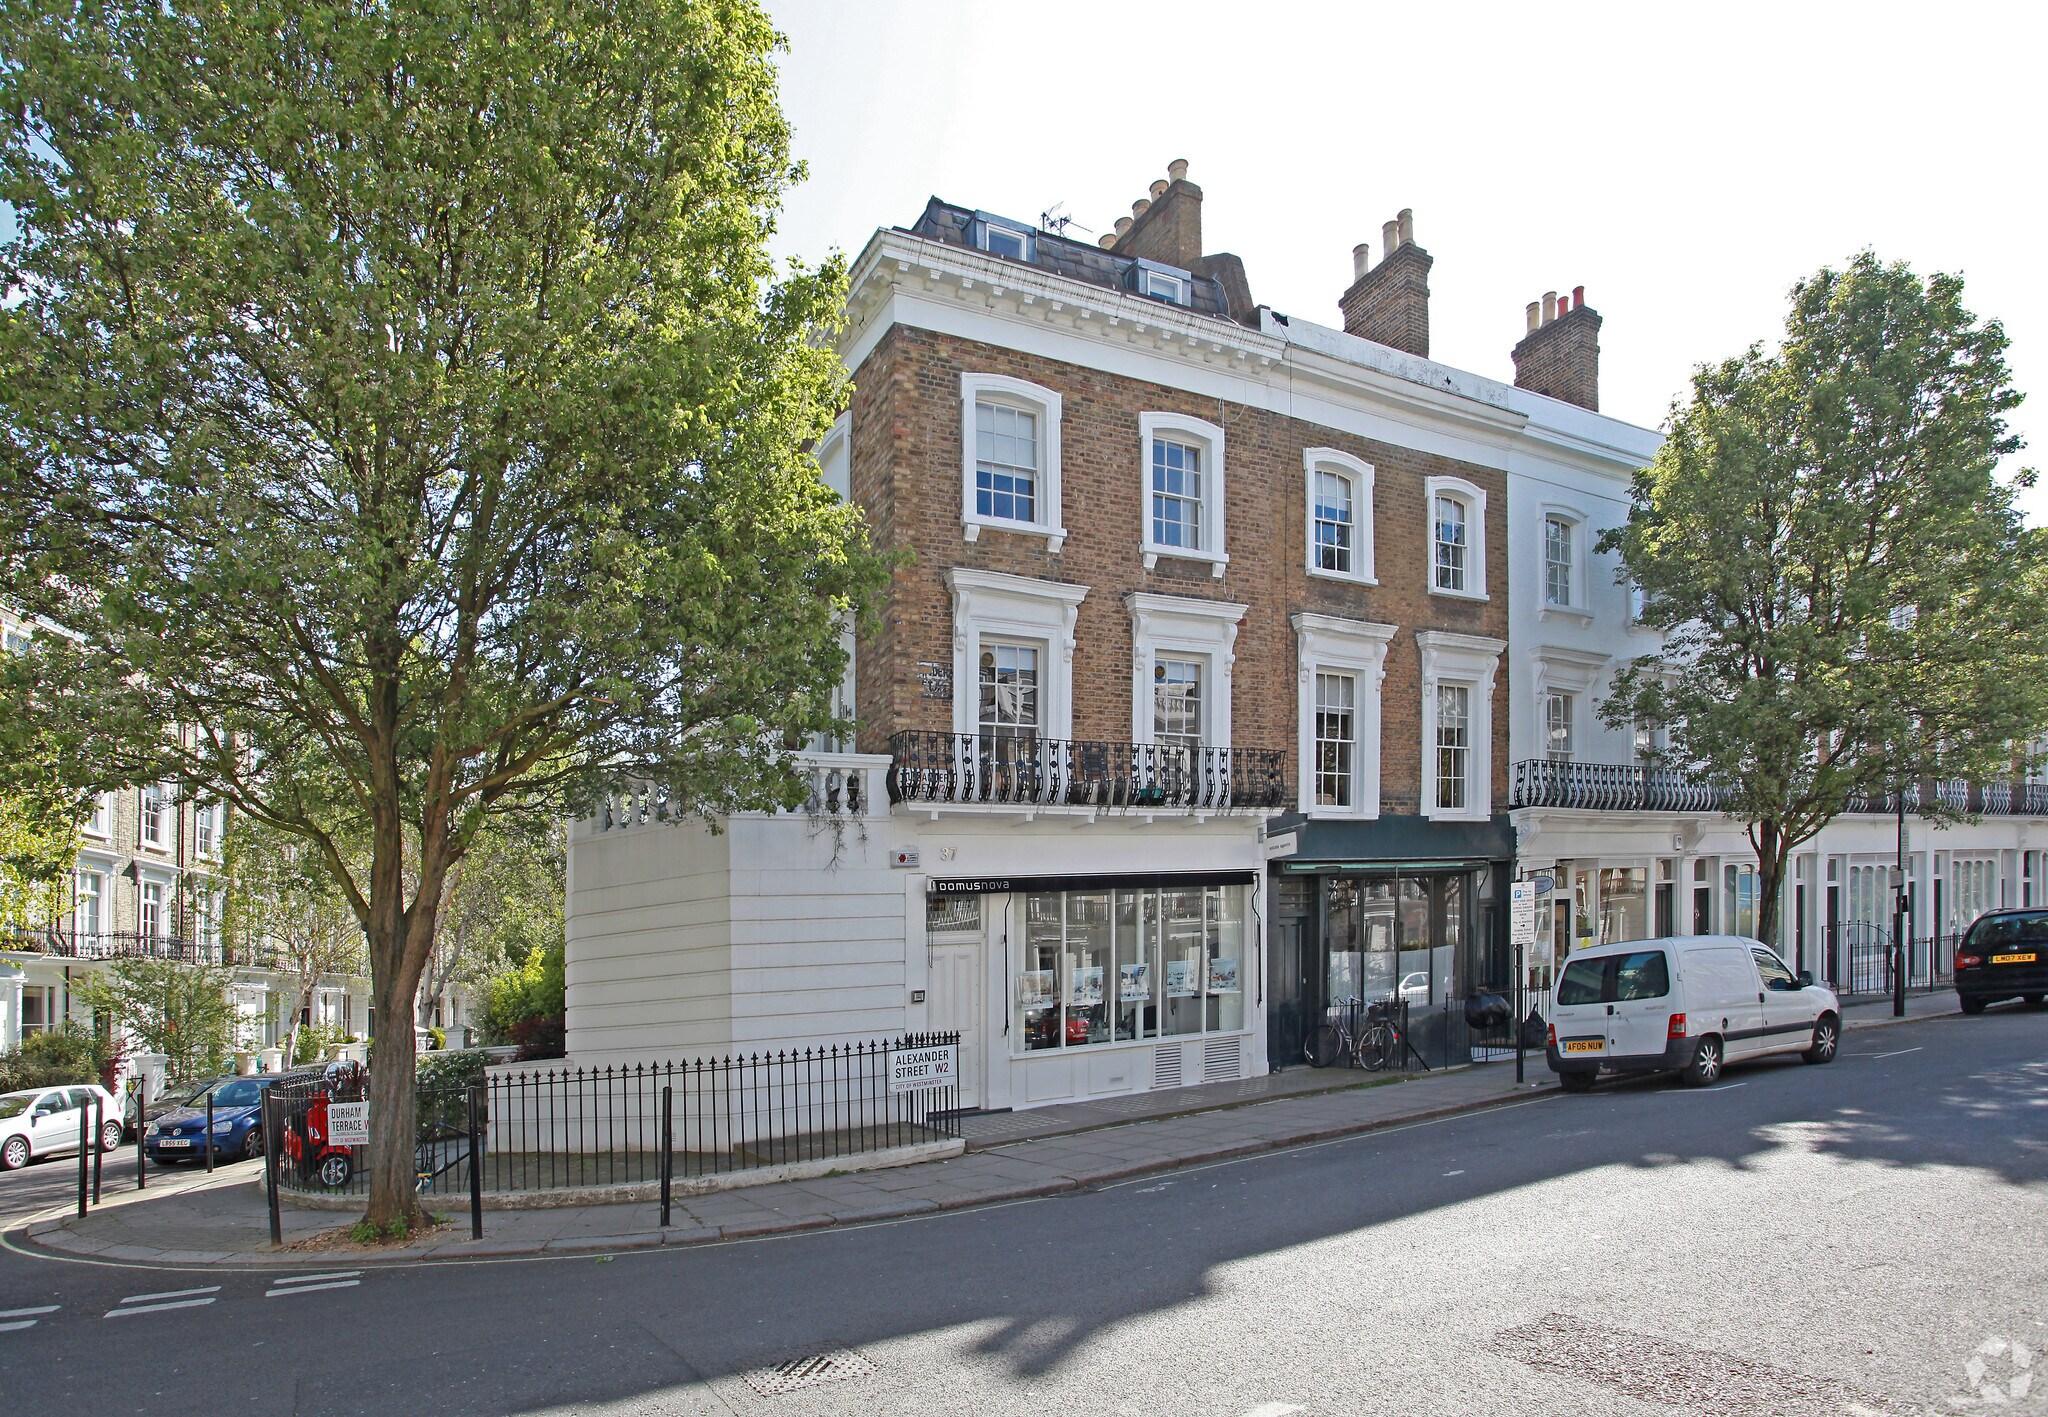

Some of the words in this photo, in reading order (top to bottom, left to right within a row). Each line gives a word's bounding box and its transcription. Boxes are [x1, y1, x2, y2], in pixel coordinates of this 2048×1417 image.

[940, 848, 957, 861] 37
[1568, 1043, 1586, 1051] AF06
[896, 1050, 949, 1066] ALEXANDER
[896, 1064, 929, 1078] STREET
[935, 1063, 948, 1073] W2
[332, 1107, 362, 1118] DURHAM
[332, 1120, 362, 1131] TERRACE
